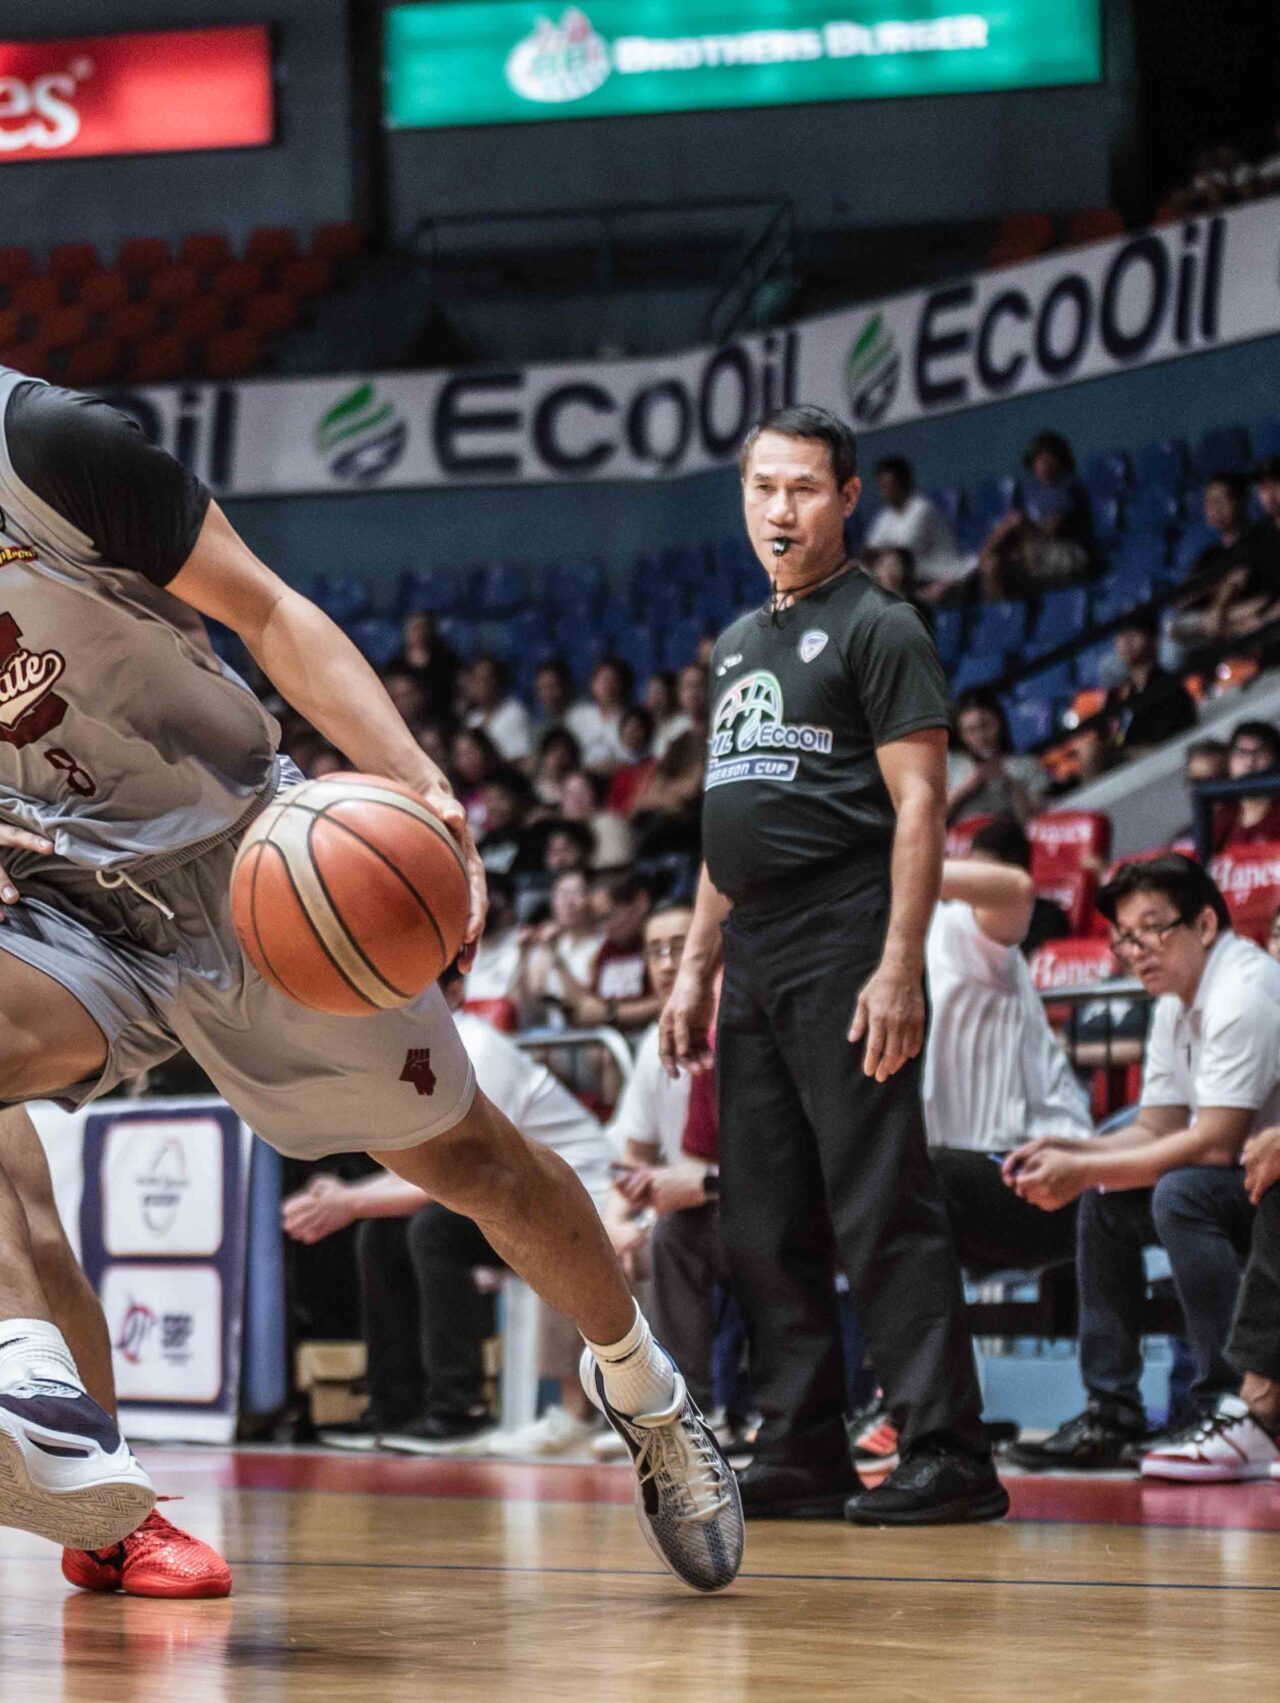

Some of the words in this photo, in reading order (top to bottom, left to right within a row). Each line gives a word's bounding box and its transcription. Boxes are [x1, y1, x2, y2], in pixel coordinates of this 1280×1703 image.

[915, 216, 1227, 404] EcoOil
[434, 332, 798, 475] EcoOil
[759, 725, 831, 753] EcoOil
[44, 748, 97, 797] 8
[754, 761, 790, 776] CUP
